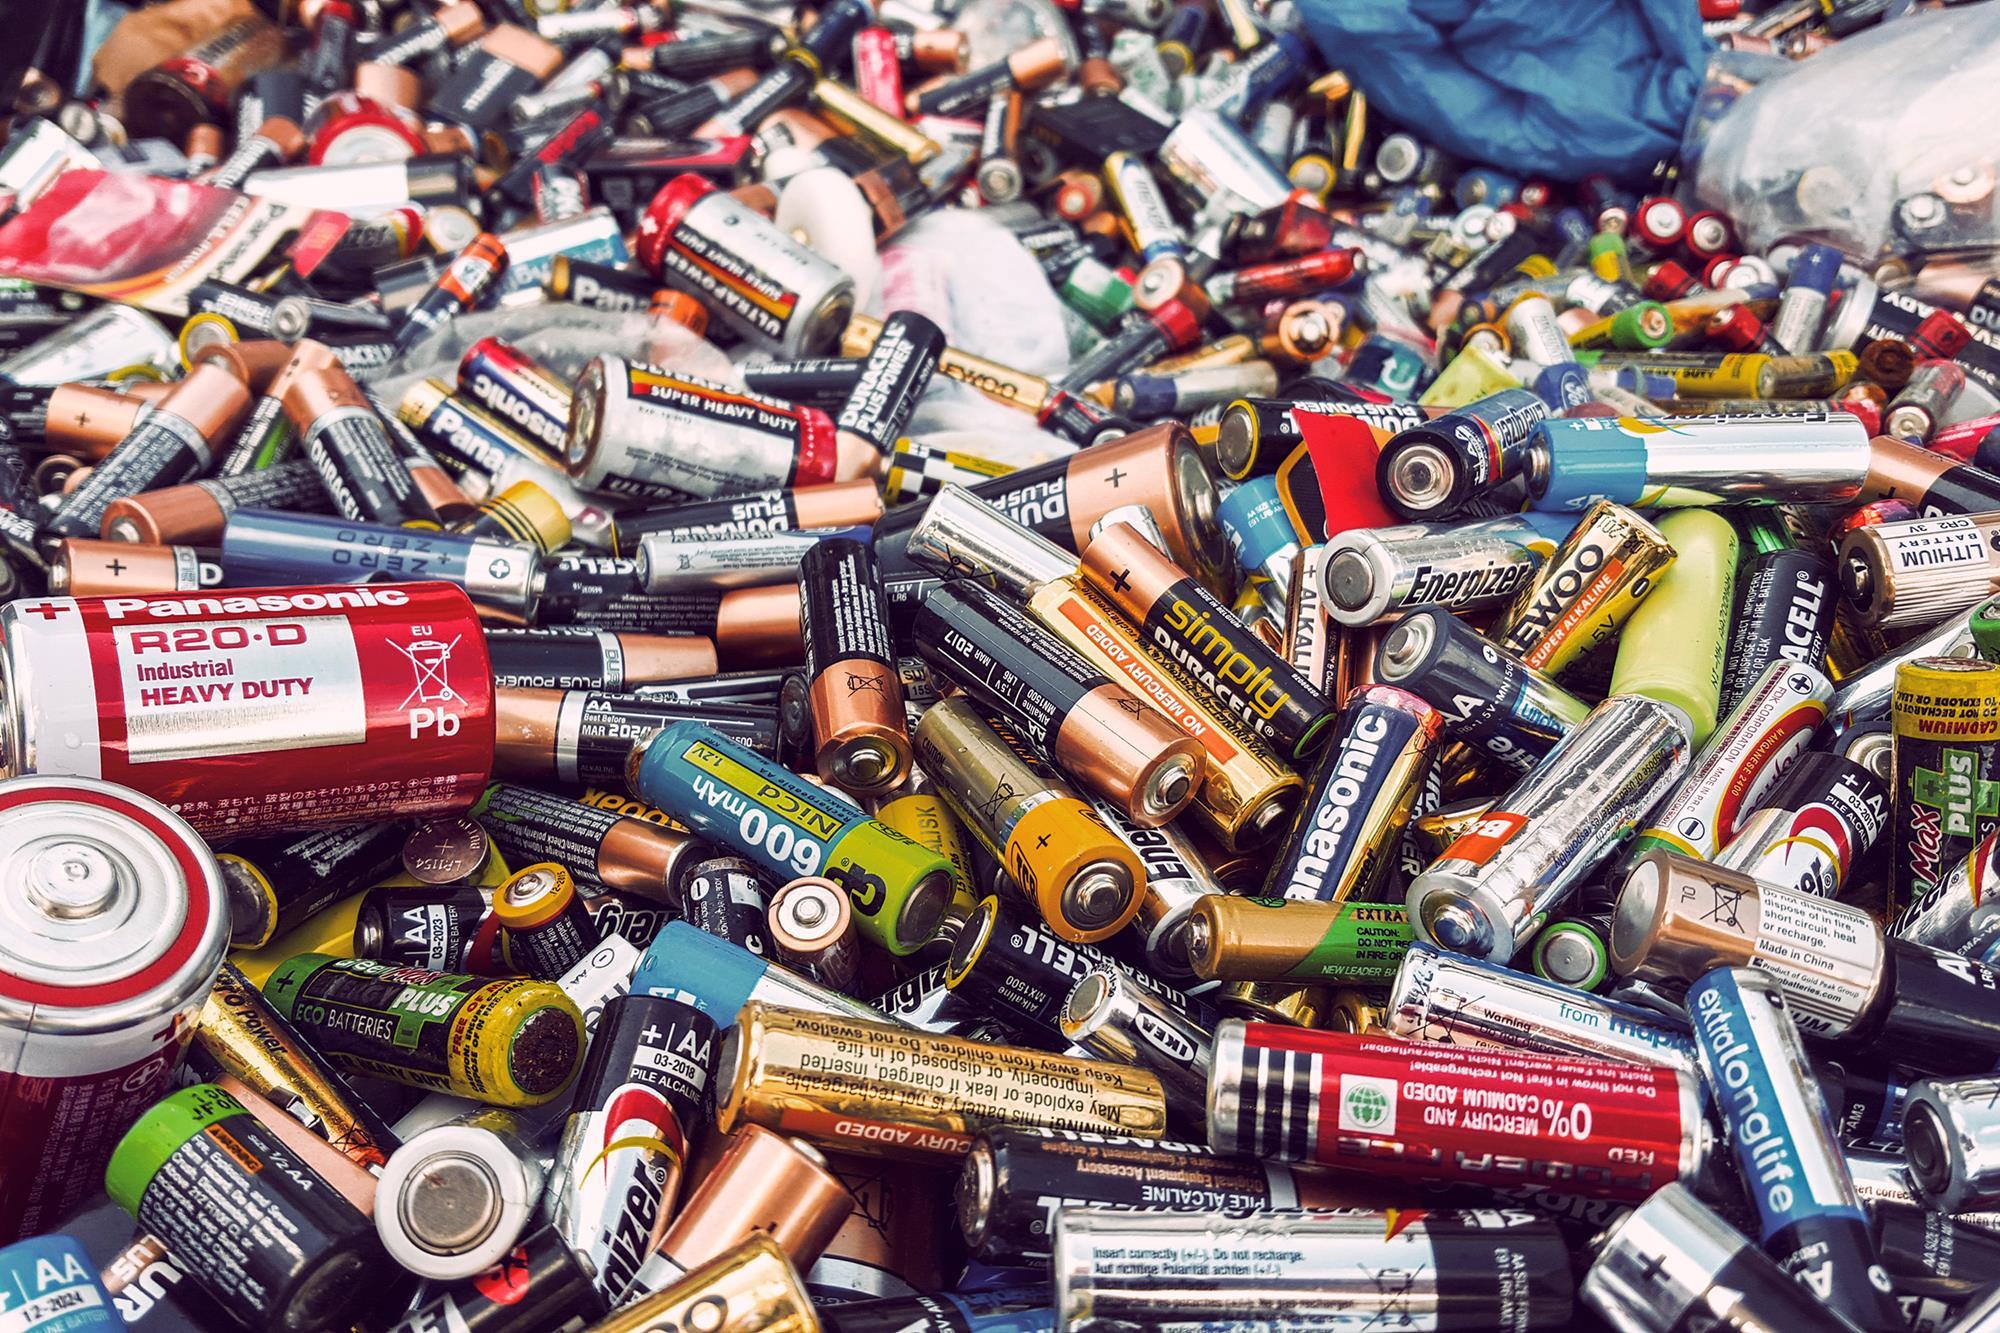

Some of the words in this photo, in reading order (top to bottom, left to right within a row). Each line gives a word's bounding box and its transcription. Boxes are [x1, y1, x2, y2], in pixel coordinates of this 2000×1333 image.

[650, 385, 701, 409] SUPER
[703, 401, 756, 420] HEAVY
[759, 411, 798, 432] DUTY
[731, 499, 787, 521] PLUS
[1909, 523, 1929, 533] 3V
[1948, 519, 1969, 529] CR2
[1898, 532, 1979, 549] BATTERY
[1901, 543, 1984, 568] LITHIUM
[1400, 562, 1532, 608] Energizer
[1758, 566, 1776, 599] BATTERY
[106, 585, 410, 619] Panasonic
[411, 625, 433, 637] EU
[1530, 628, 1566, 667] SUPER
[1563, 574, 1612, 631] ALKALINE
[944, 630, 974, 658] 2017
[1085, 623, 1129, 665] ADDED
[1733, 618, 1750, 654] CONNECT
[137, 658, 234, 682] Industrial
[974, 649, 992, 666] MAR
[1163, 599, 1290, 720] simply
[1728, 655, 1740, 671] NOT
[1738, 641, 1757, 676] DISPOSE
[1752, 657, 1766, 670] OR
[560, 675, 602, 689] PLUS
[1003, 670, 1018, 686] LR6
[1124, 663, 1186, 718] MERCURY
[1734, 675, 1747, 690] OR
[141, 683, 236, 708] HEAVY
[241, 677, 314, 698] DUTY
[1027, 689, 1056, 716] MN1500
[1770, 685, 1787, 704] FDK
[583, 713, 604, 724] Best
[604, 715, 627, 725] Before
[587, 700, 612, 713] AA
[1022, 700, 1050, 726] Alkaline
[409, 707, 461, 740] Pb
[582, 724, 606, 737] MAR
[1028, 720, 1047, 742] AA
[1182, 715, 1205, 736] NO
[1727, 702, 1774, 764] CORPORATION
[1918, 719, 1999, 736] CADMIUM
[691, 746, 724, 768] 1.2V
[1744, 727, 1785, 774] MANGANESE
[1706, 767, 1725, 787] MADE
[1731, 776, 1747, 797] 2400
[1825, 795, 1847, 814] PILE
[1947, 752, 1973, 834] PLUS
[757, 783, 836, 835] NiCd
[1284, 714, 1388, 901] anasonic
[1848, 795, 1875, 830] 03-2019
[1867, 794, 1888, 833] AA
[693, 773, 821, 876] 600mAh
[1550, 820, 1595, 872] responsibly
[414, 857, 464, 872] LR1154
[1780, 895, 1797, 903] not
[404, 905, 427, 945] AA
[448, 904, 459, 933] BATTERY
[1356, 908, 1402, 922] EXTRA
[1765, 899, 1805, 916] dispose
[1809, 912, 1819, 920] of
[1822, 915, 1831, 924] in
[1834, 919, 1854, 933] fire,
[1765, 909, 1792, 924] short
[1795, 918, 1830, 937] circuit,
[1834, 930, 1856, 944] heat
[431, 913, 443, 960] 03-2023
[1356, 927, 1400, 938] CAUTION:
[1358, 938, 1368, 948] DO
[1371, 939, 1392, 948] NOT
[1763, 922, 1774, 931] or
[1777, 925, 1826, 948] recharge.
[1759, 940, 1787, 956] Made
[1790, 949, 1800, 959] in
[1804, 954, 1834, 970] China
[1117, 956, 1188, 1009] ULTRA
[1346, 966, 1382, 976] LEADER
[1762, 963, 1790, 977] Product
[1819, 981, 1835, 990] Peak
[1837, 984, 1859, 998] Group
[998, 985, 1038, 1014] Alkaline
[1005, 975, 1046, 1000] MX1500
[392, 988, 459, 1018] PLUS
[1559, 1000, 1600, 1028] from
[296, 1004, 325, 1026] ECO
[327, 1006, 395, 1042] BATTERIES
[452, 1017, 468, 1057] FREE
[467, 993, 485, 1012] OF
[790, 1017, 865, 1042] swallow.
[1483, 1007, 1532, 1035] Warning
[676, 1029, 712, 1069] AA
[828, 1039, 866, 1061] fire.
[866, 1030, 895, 1048] not
[897, 1035, 922, 1052] Do
[1141, 1018, 1189, 1057] IKEA
[867, 1046, 885, 1063] in
[887, 1049, 907, 1067] of
[909, 1050, 984, 1079] disposed
[923, 1039, 996, 1066] children.
[997, 1051, 1037, 1071] from
[653, 1052, 696, 1081] 03-2018
[798, 1052, 869, 1081] inserted
[871, 1061, 945, 1092] charged,
[984, 1065, 1004, 1081] or
[1038, 1057, 1082, 1076] away
[1082, 1065, 1124, 1086] Keep
[1409, 1060, 1498, 1080] rechargeable!
[1499, 1070, 1524, 1084] Not
[630, 1067, 658, 1085] PILE
[658, 1075, 701, 1105] ALCALINE
[777, 1068, 901, 1105] rechargeable.
[948, 1077, 962, 1095] if
[963, 1080, 1000, 1102] leak
[1006, 1064, 1096, 1097] improperly,
[1401, 1080, 1459, 1104] ADDED
[1526, 1073, 1554, 1087] fire!
[1555, 1076, 1569, 1088] in
[1571, 1078, 1610, 1093] throw
[1611, 1082, 1634, 1095] not
[1635, 1084, 1657, 1098] Do
[901, 1090, 927, 1109] not
[1001, 1085, 1021, 1103] or
[1023, 1085, 1086, 1113] explode
[1461, 1087, 1541, 1114] CADMIUM
[1698, 988, 1795, 1214] extralonglife
[949, 1096, 1008, 1122] battery
[1088, 1097, 1123, 1120] May
[1422, 1105, 1457, 1126] AND
[1540, 1098, 1595, 1142] 0%
[833, 1119, 911, 1144] ADDED
[1459, 1110, 1540, 1137] MERCURY
[1607, 1147, 1655, 1166] RED
[161, 1161, 193, 1191] Above
[1076, 1159, 1144, 1180] Accessory
[1145, 1166, 1213, 1187] Equipment
[189, 1133, 214, 1156] Fire,
[207, 1149, 255, 1193] Explosion,
[248, 1187, 272, 1210] and
[266, 1203, 302, 1237] Severe
[1140, 1184, 1226, 1209] ALCALINE
[35, 1252, 91, 1287] AA
[21, 1290, 85, 1325] 12-2024
